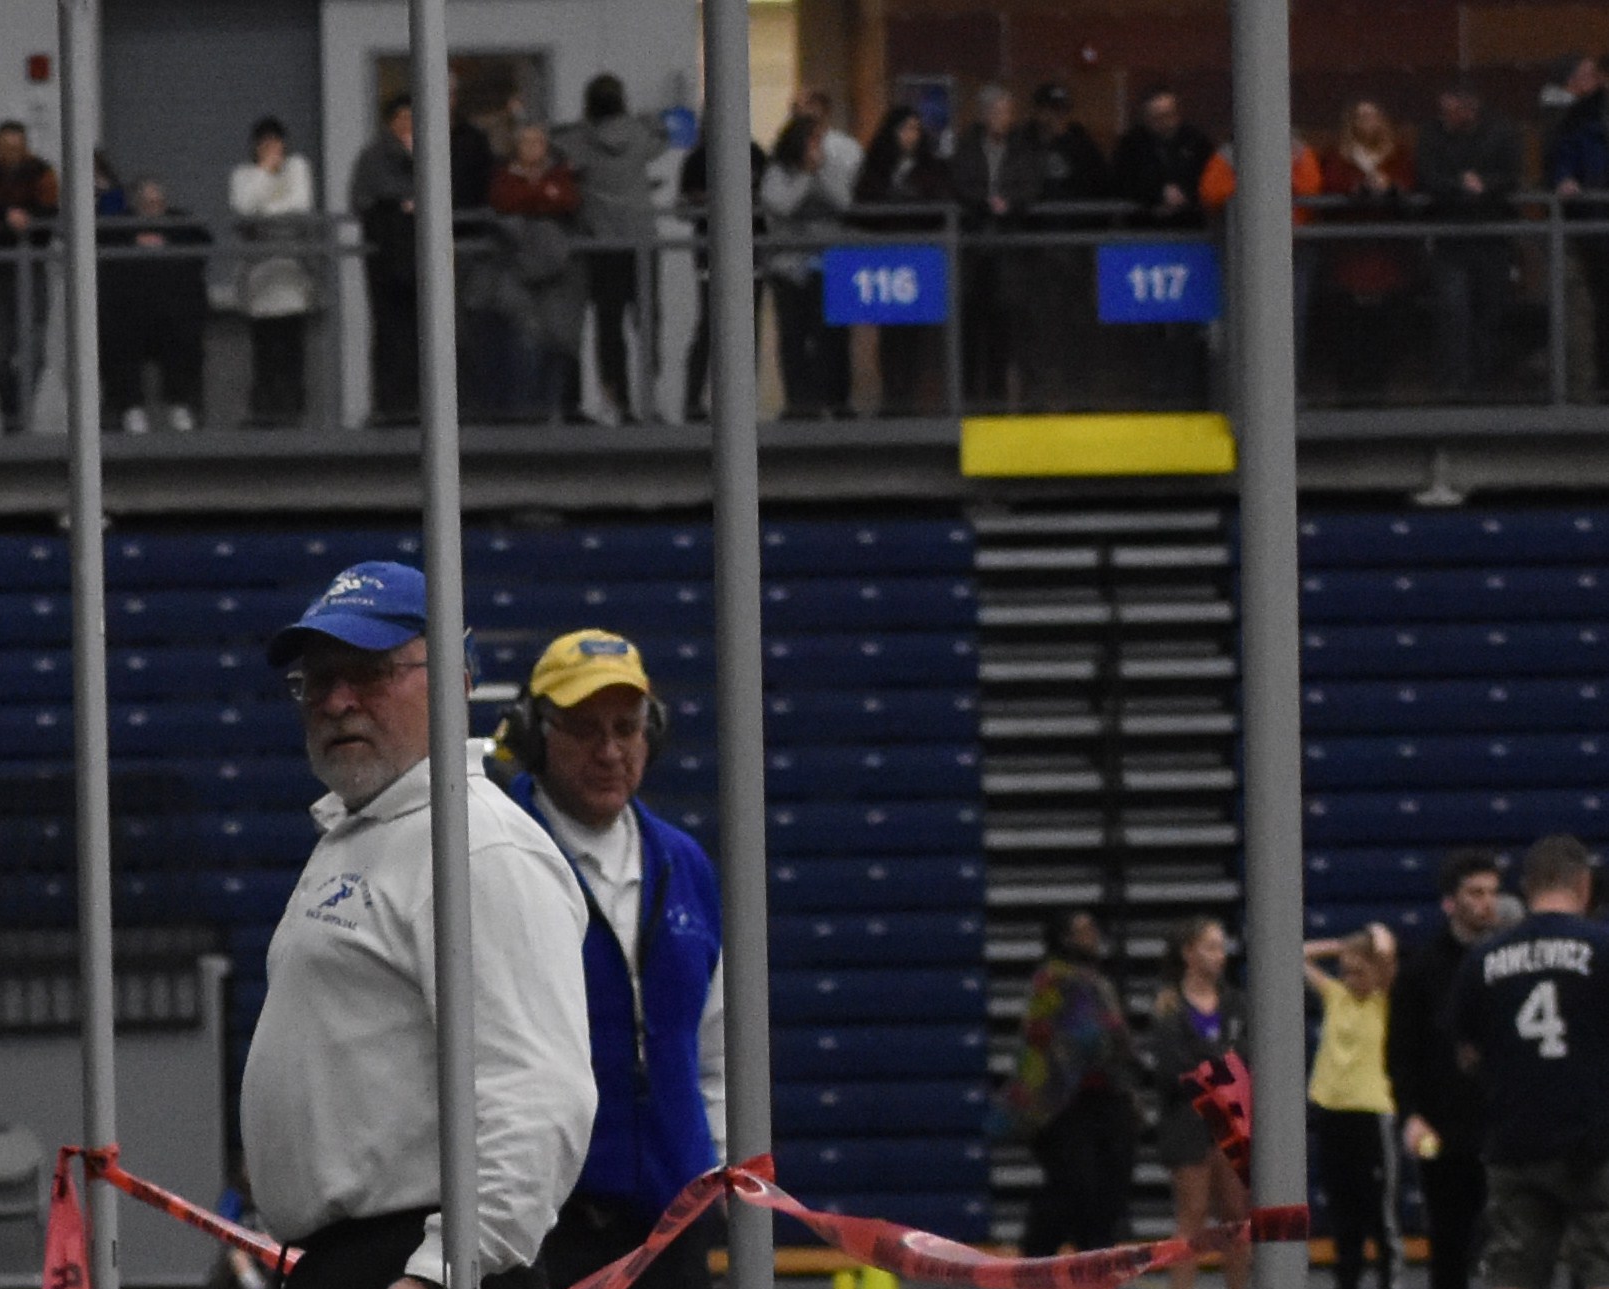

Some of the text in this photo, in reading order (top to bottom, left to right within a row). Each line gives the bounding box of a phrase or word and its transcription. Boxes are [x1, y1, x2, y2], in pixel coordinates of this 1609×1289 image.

[852, 265, 919, 306] 116
[1127, 263, 1191, 303] 117
[1515, 979, 1569, 1059] 4
